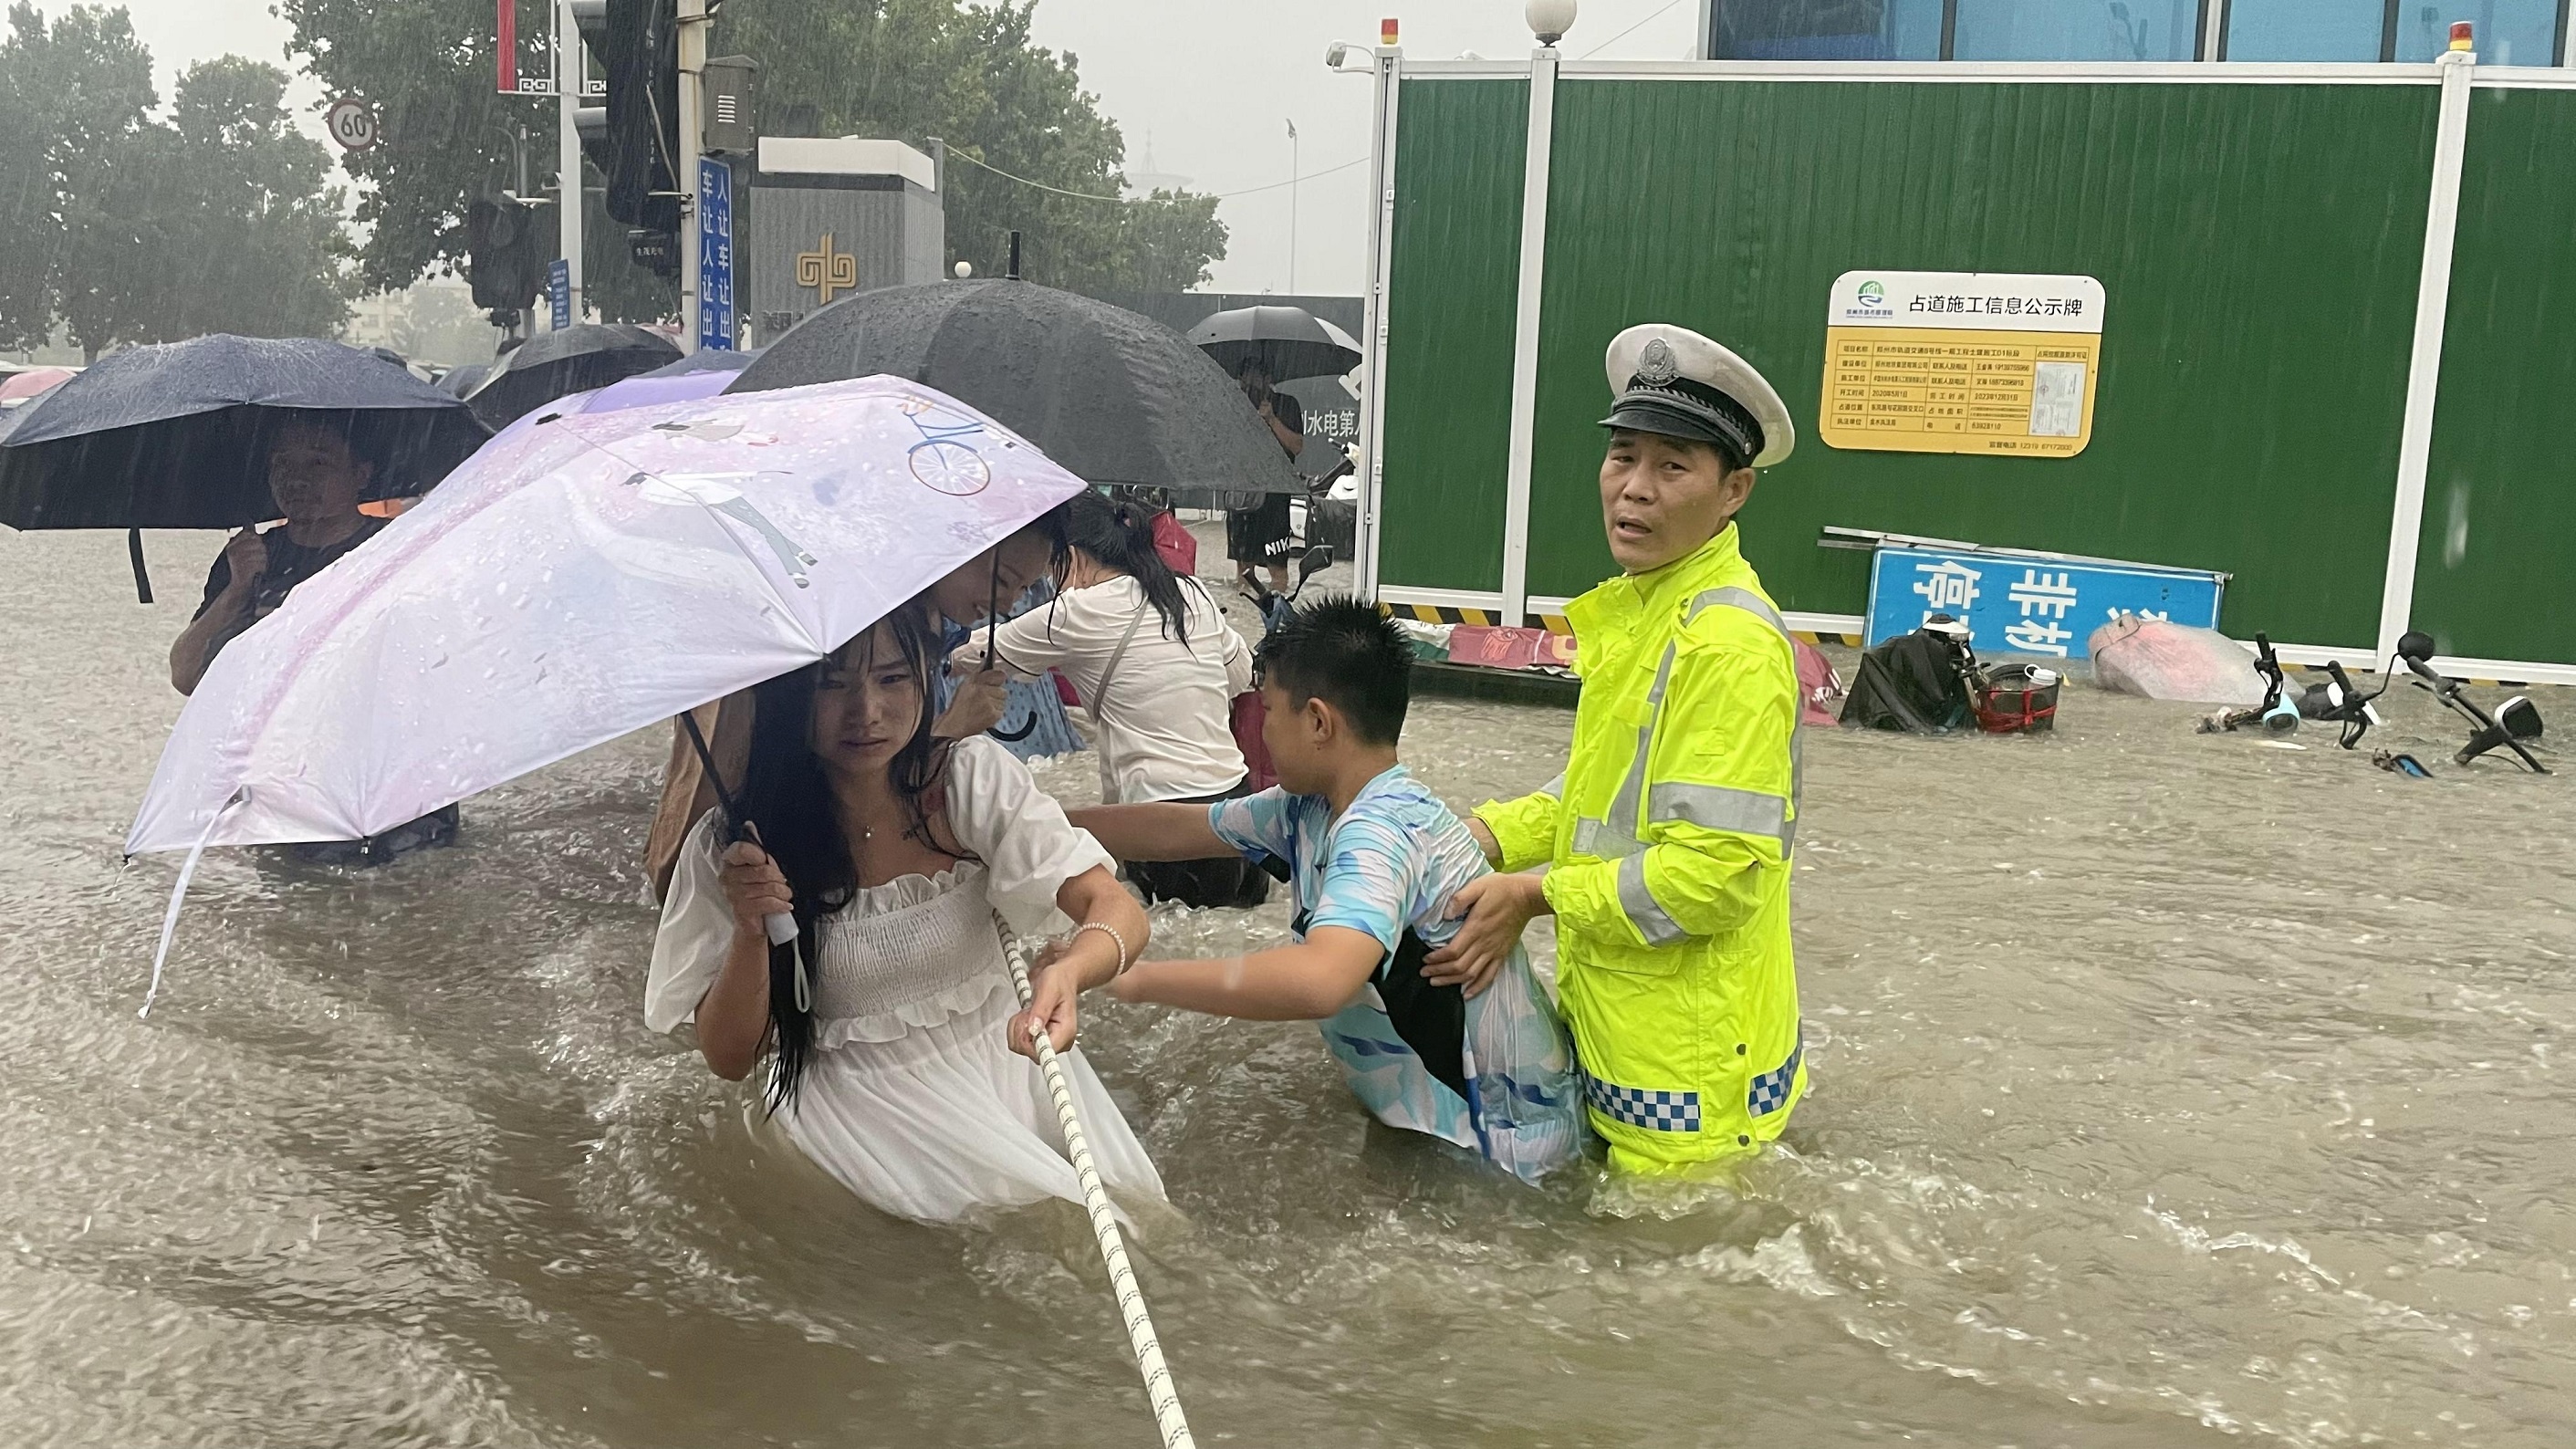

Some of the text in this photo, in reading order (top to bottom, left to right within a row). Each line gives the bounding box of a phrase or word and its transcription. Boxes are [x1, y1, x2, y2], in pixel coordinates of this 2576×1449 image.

[341, 113, 366, 137] 60
[718, 173, 730, 351] 人让车让出
[1909, 295, 2082, 317] 占道施工信息公示牌
[1301, 410, 1361, 437] 水电第
[1265, 537, 1289, 556] NIK
